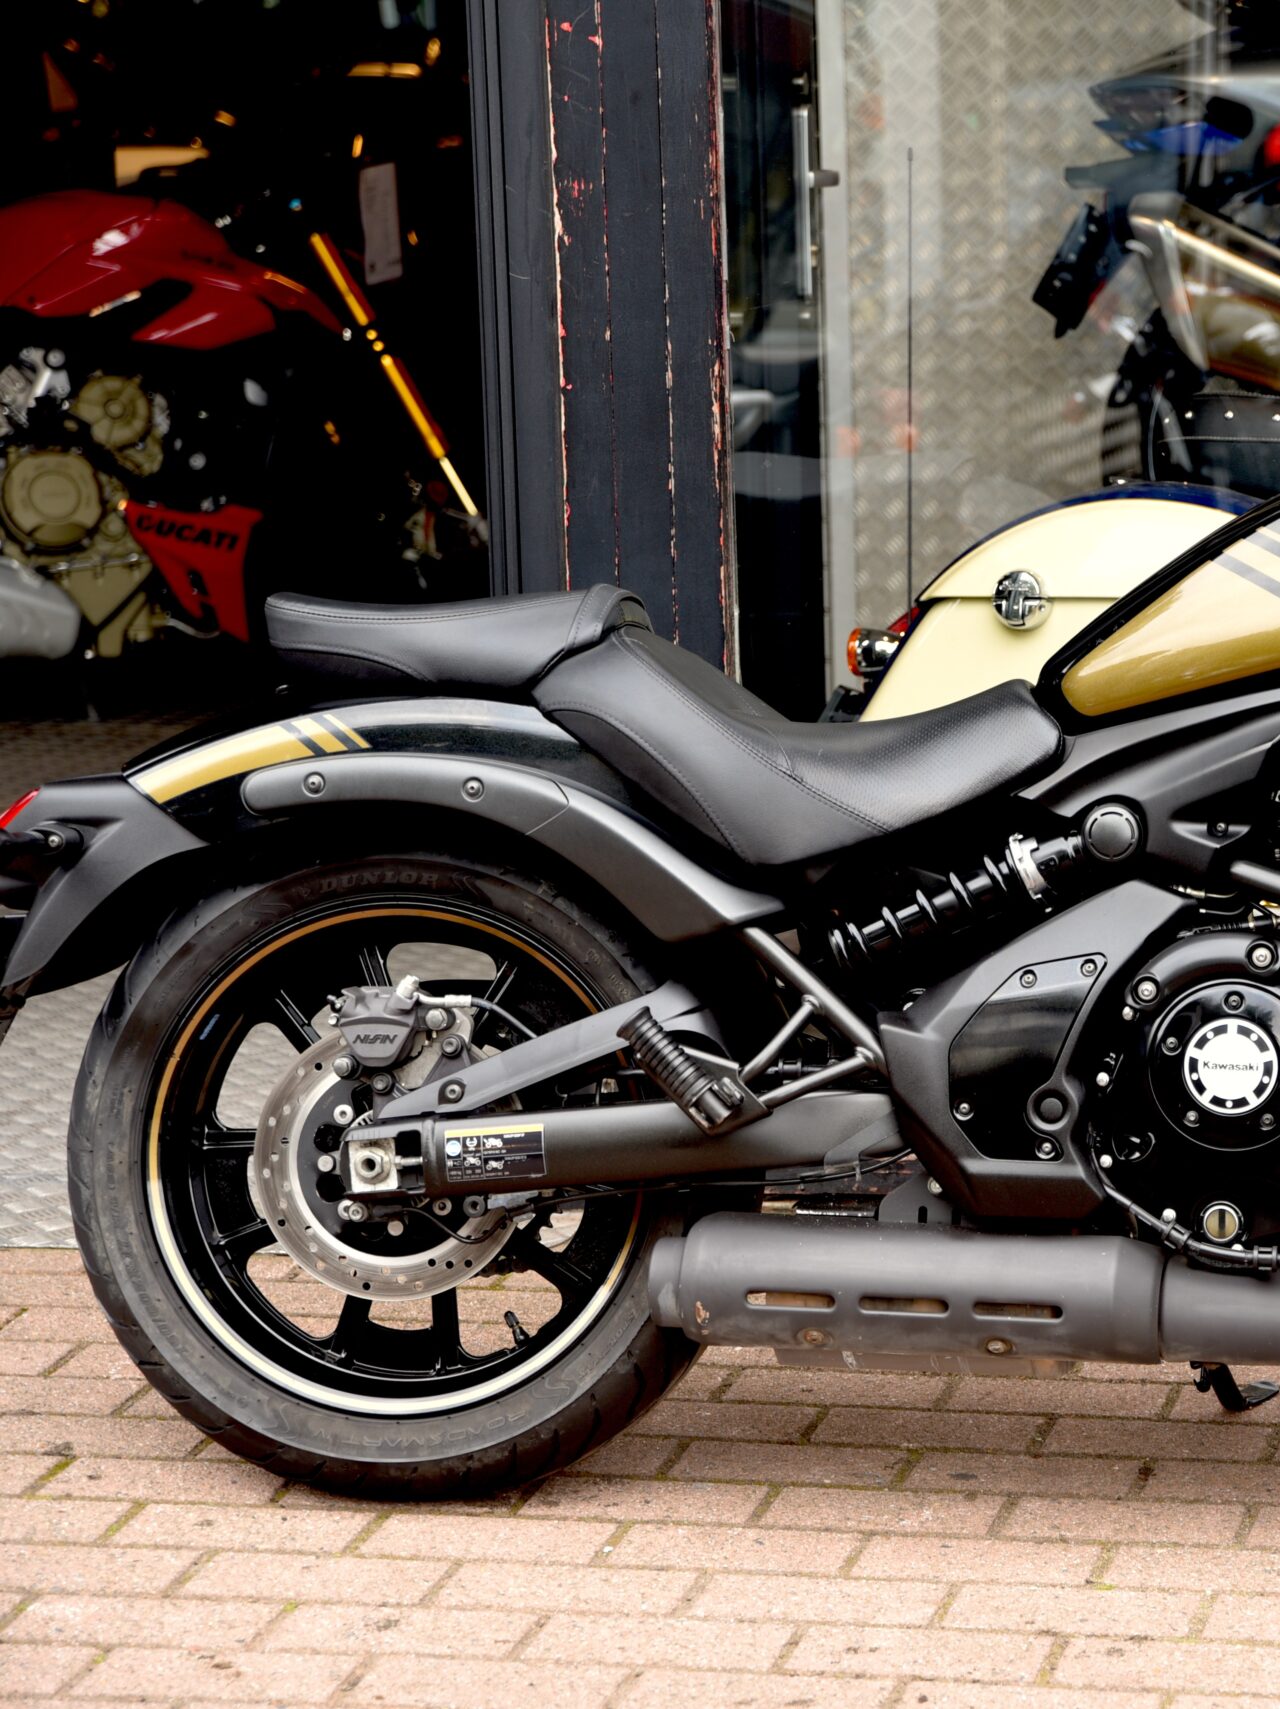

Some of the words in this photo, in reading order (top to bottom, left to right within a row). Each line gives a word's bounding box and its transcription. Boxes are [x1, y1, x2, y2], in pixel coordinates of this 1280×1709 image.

[135, 513, 240, 552] DUCATI
[319, 870, 440, 894] DUNLOP
[1202, 1060, 1259, 1072] Kawasaki
